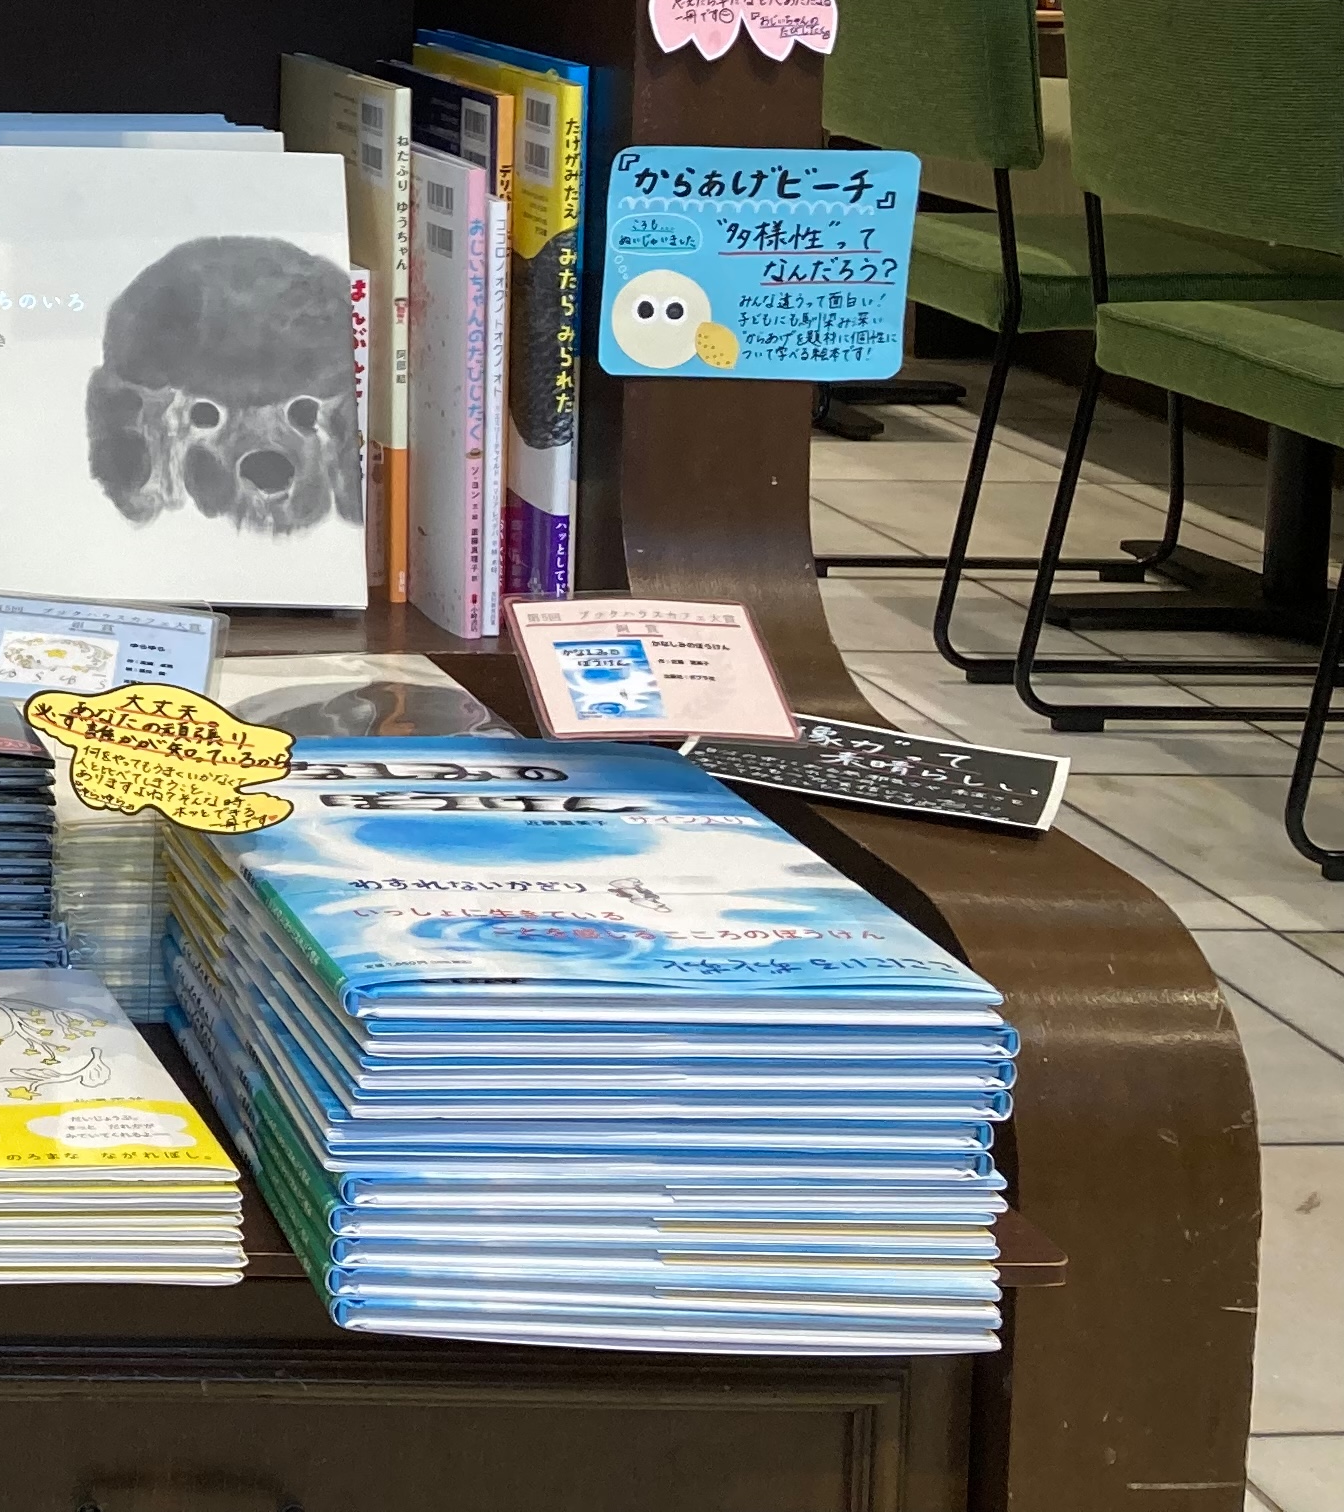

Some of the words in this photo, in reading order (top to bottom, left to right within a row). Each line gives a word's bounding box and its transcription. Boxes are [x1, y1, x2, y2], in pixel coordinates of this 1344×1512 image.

[619, 154, 896, 209] 『からあげビーチ』
[578, 610, 735, 624] ブックハウスカフェ大賞
